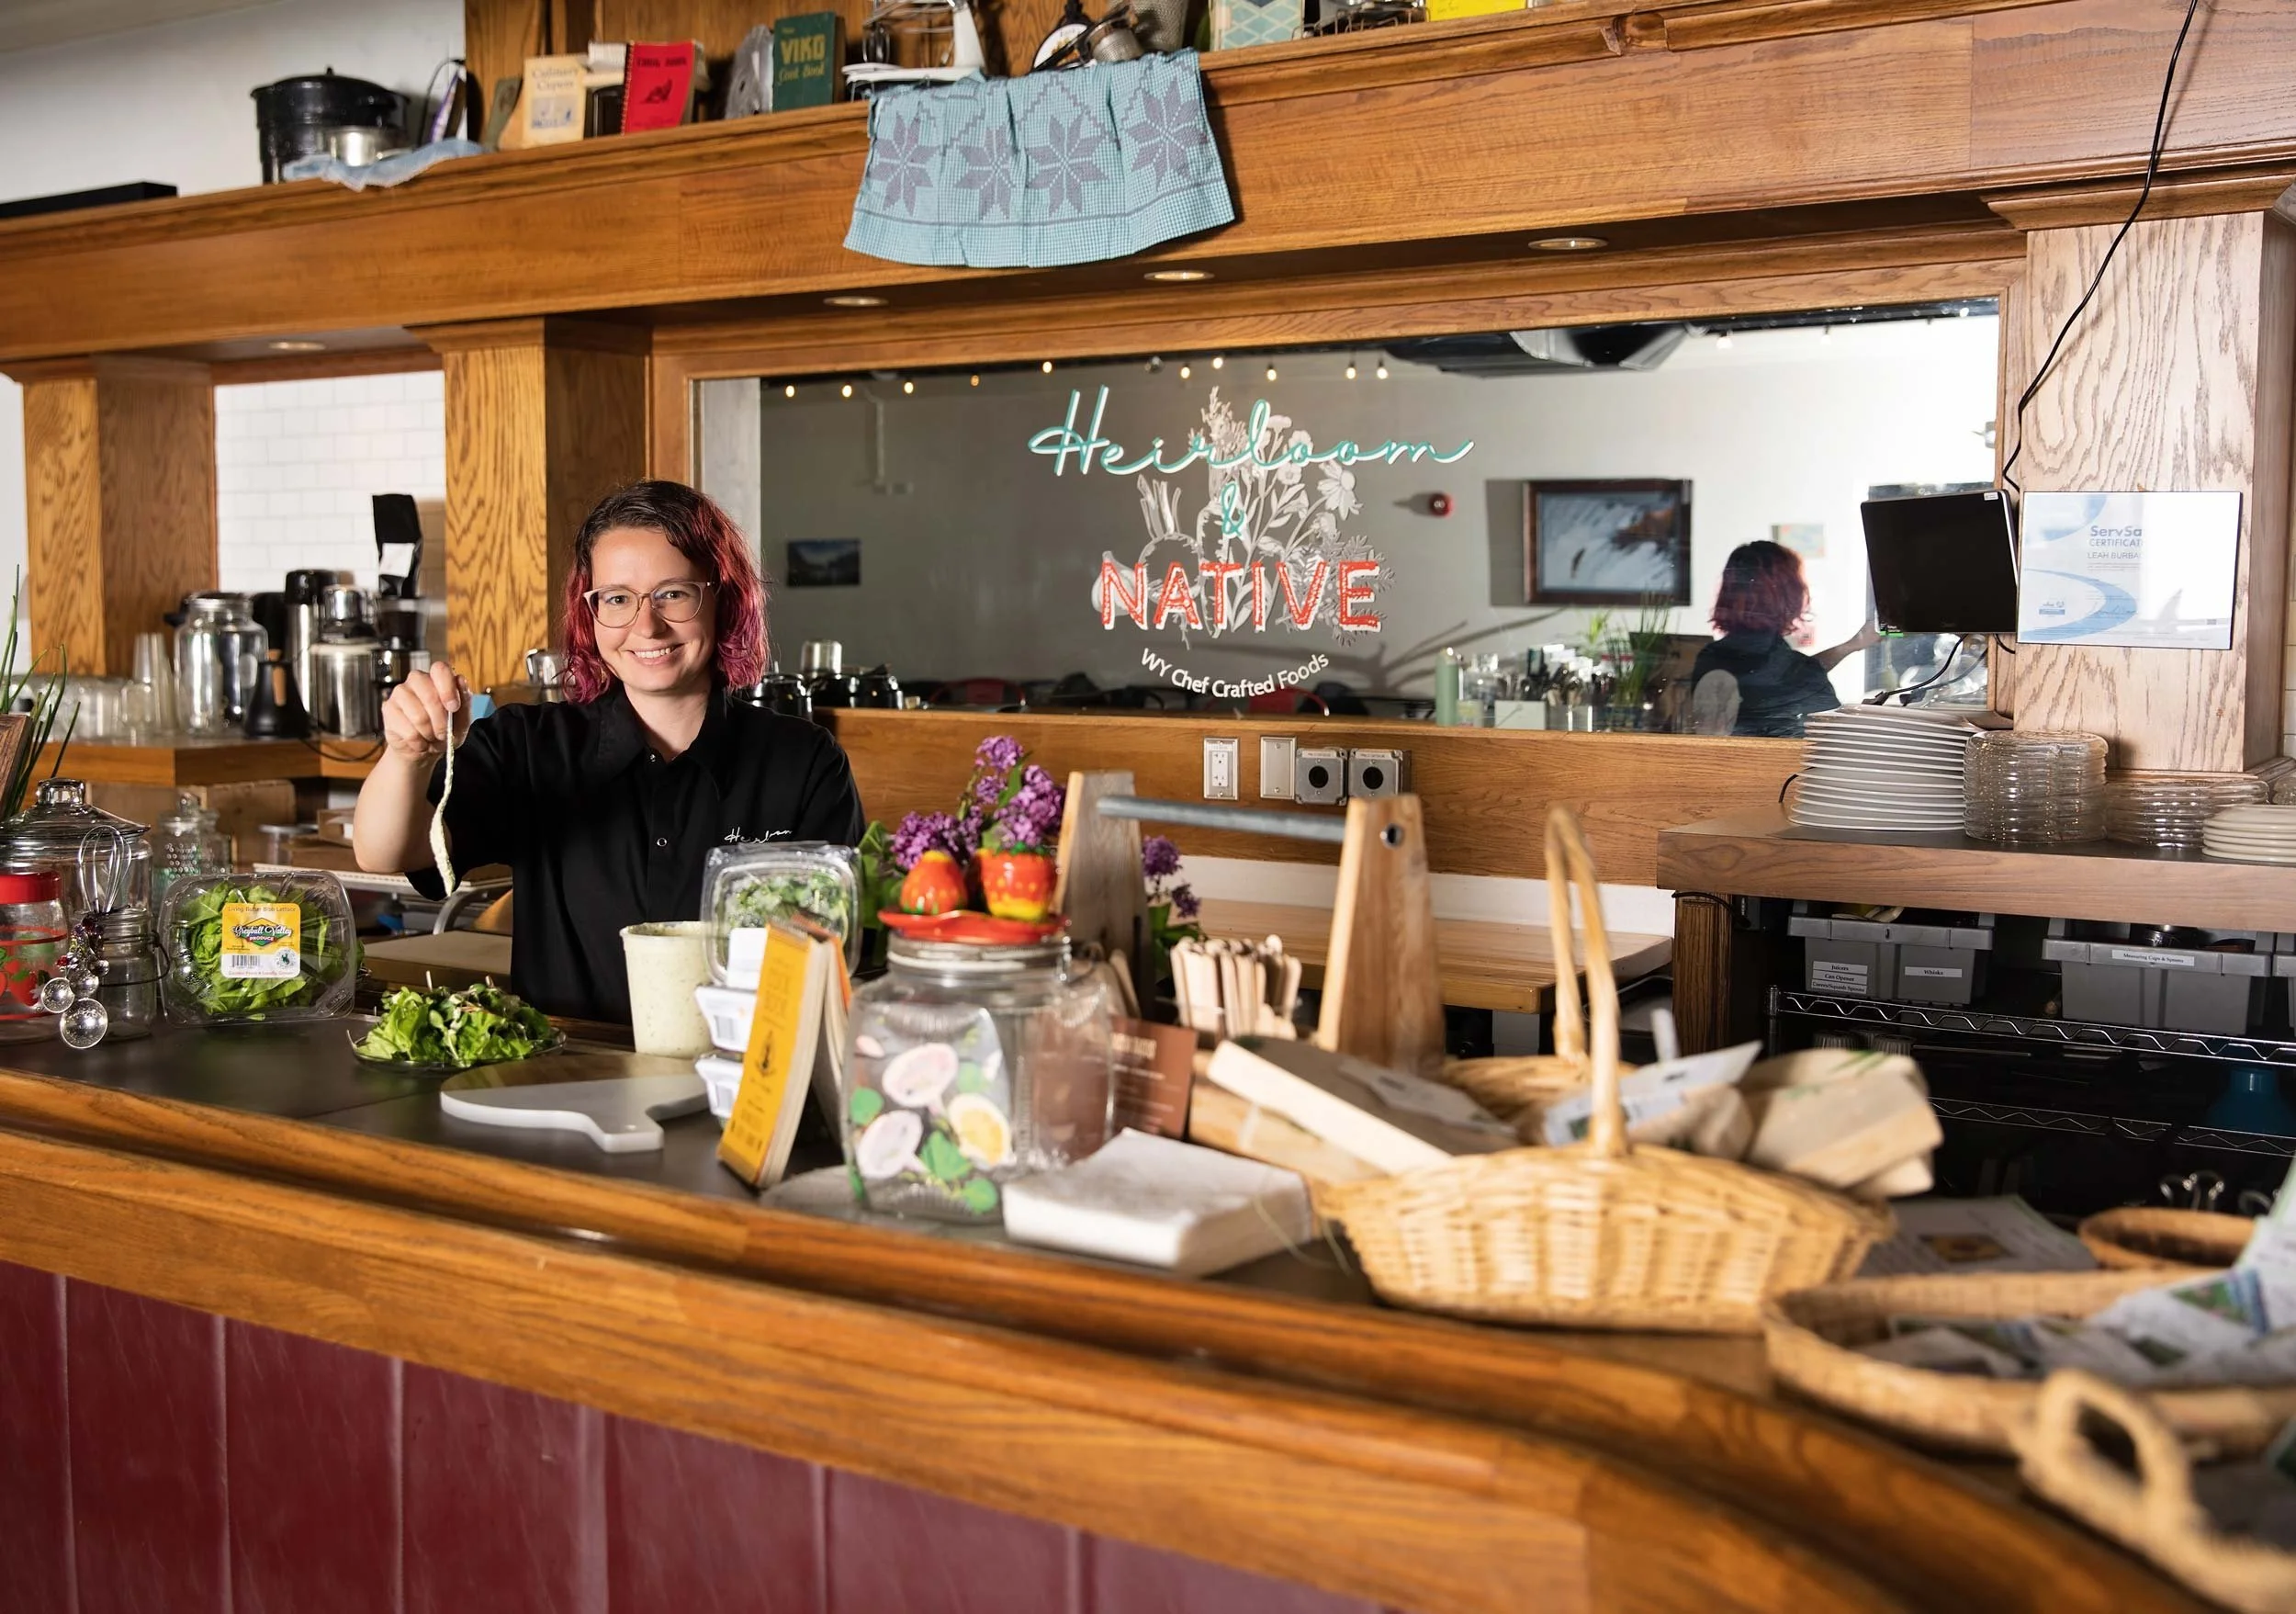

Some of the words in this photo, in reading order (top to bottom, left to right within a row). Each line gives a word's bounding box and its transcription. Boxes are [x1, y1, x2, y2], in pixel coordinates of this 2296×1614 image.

[780, 34, 826, 65] VIKO
[1028, 384, 1475, 477] Heirloom
[1219, 480, 1245, 539] &
[2090, 525, 2143, 537] ServSa
[2089, 538, 2142, 547] CERTIFICAT
[2110, 551, 2141, 559] BURBA
[1100, 560, 1382, 632] NATIVE
[1141, 648, 1173, 677] WY
[1171, 668, 1210, 695] Chef
[1211, 673, 1275, 698] Crafted
[1277, 652, 1329, 690] Foods
[264, 924, 293, 936] Valley
[2123, 953, 2148, 961] Measuring
